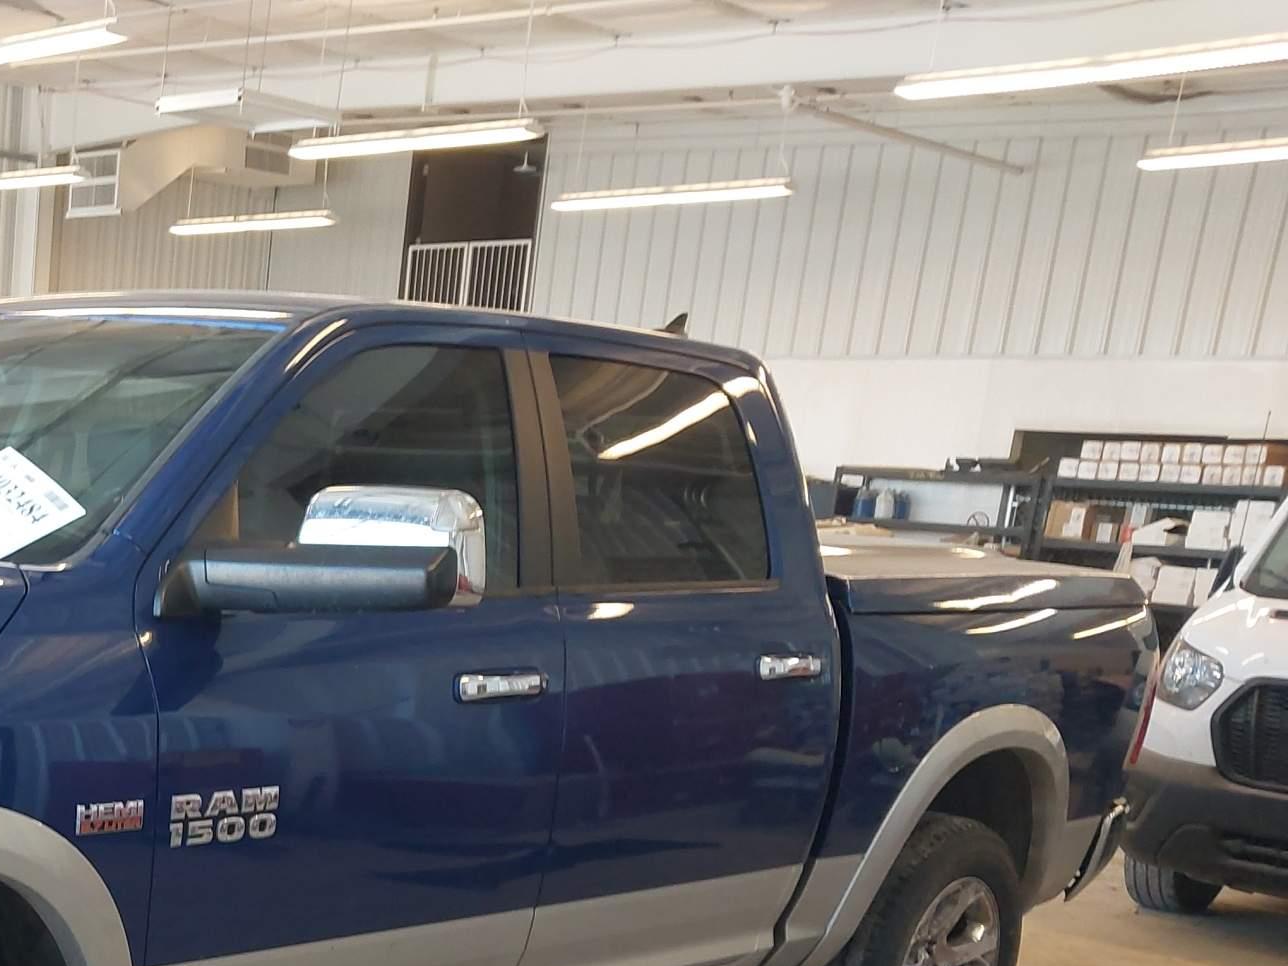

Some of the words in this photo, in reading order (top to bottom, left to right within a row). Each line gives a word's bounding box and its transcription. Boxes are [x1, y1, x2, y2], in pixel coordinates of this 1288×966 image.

[76, 799, 144, 836] HEMI
[170, 785, 280, 820] RAM
[169, 812, 278, 849] 1500
